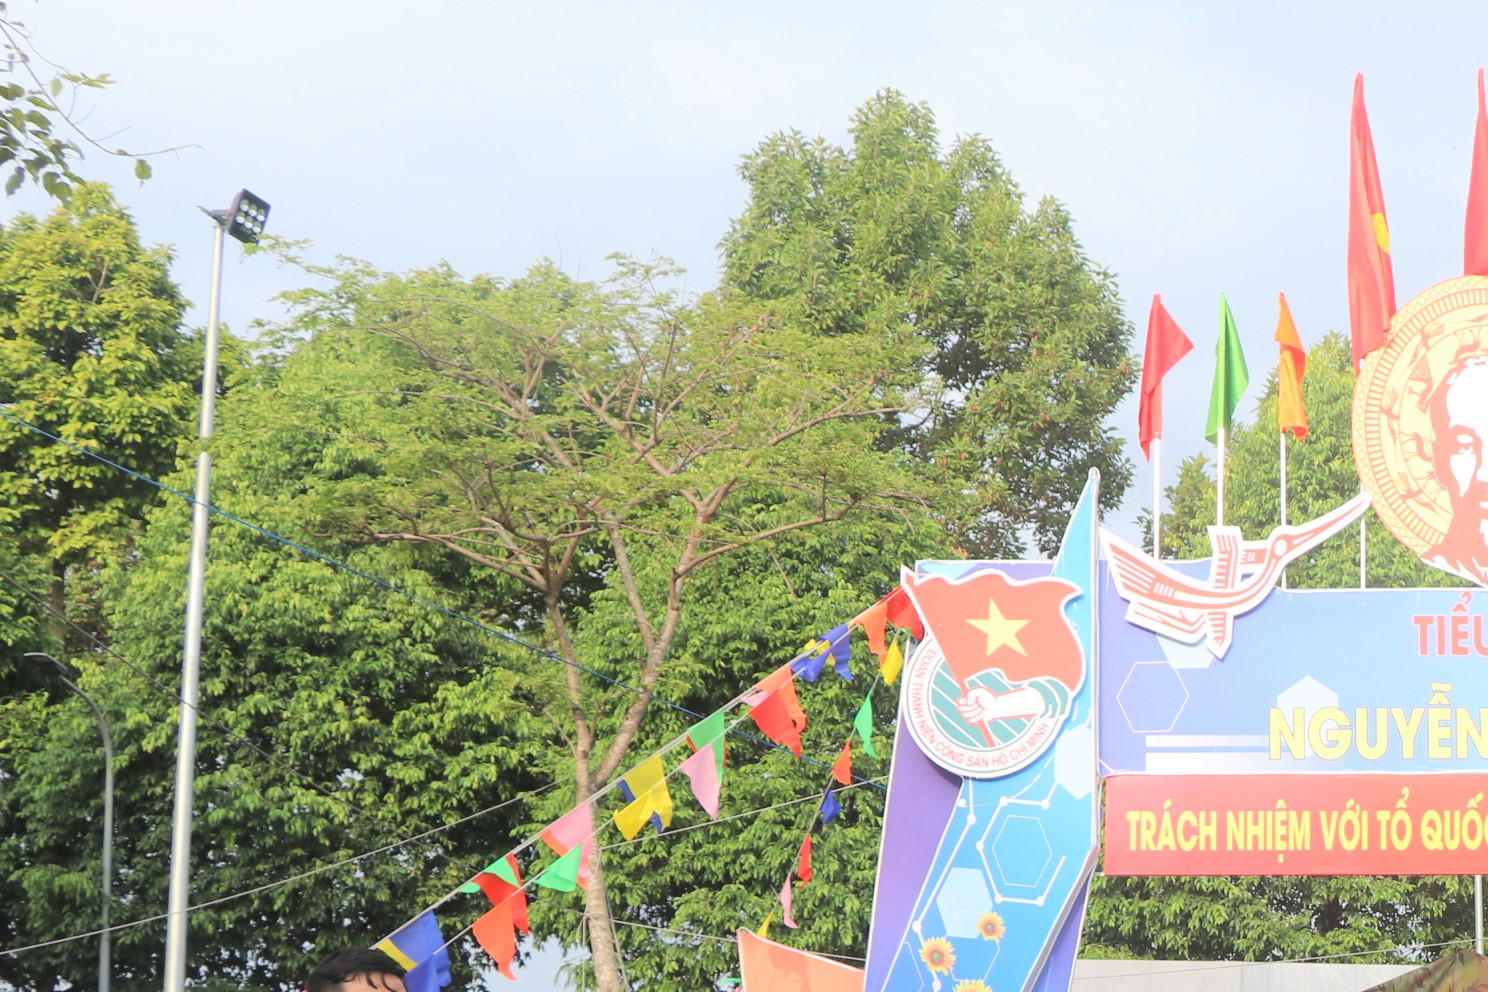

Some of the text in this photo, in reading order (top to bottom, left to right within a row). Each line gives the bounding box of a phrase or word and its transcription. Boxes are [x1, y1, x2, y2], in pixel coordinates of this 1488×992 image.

[912, 682, 925, 718] THANH
[1126, 798, 1217, 851] TRÁCH
[1227, 799, 1311, 863] NHIỆM
[1320, 798, 1368, 851] VỚI
[1377, 786, 1412, 850] TỔ
